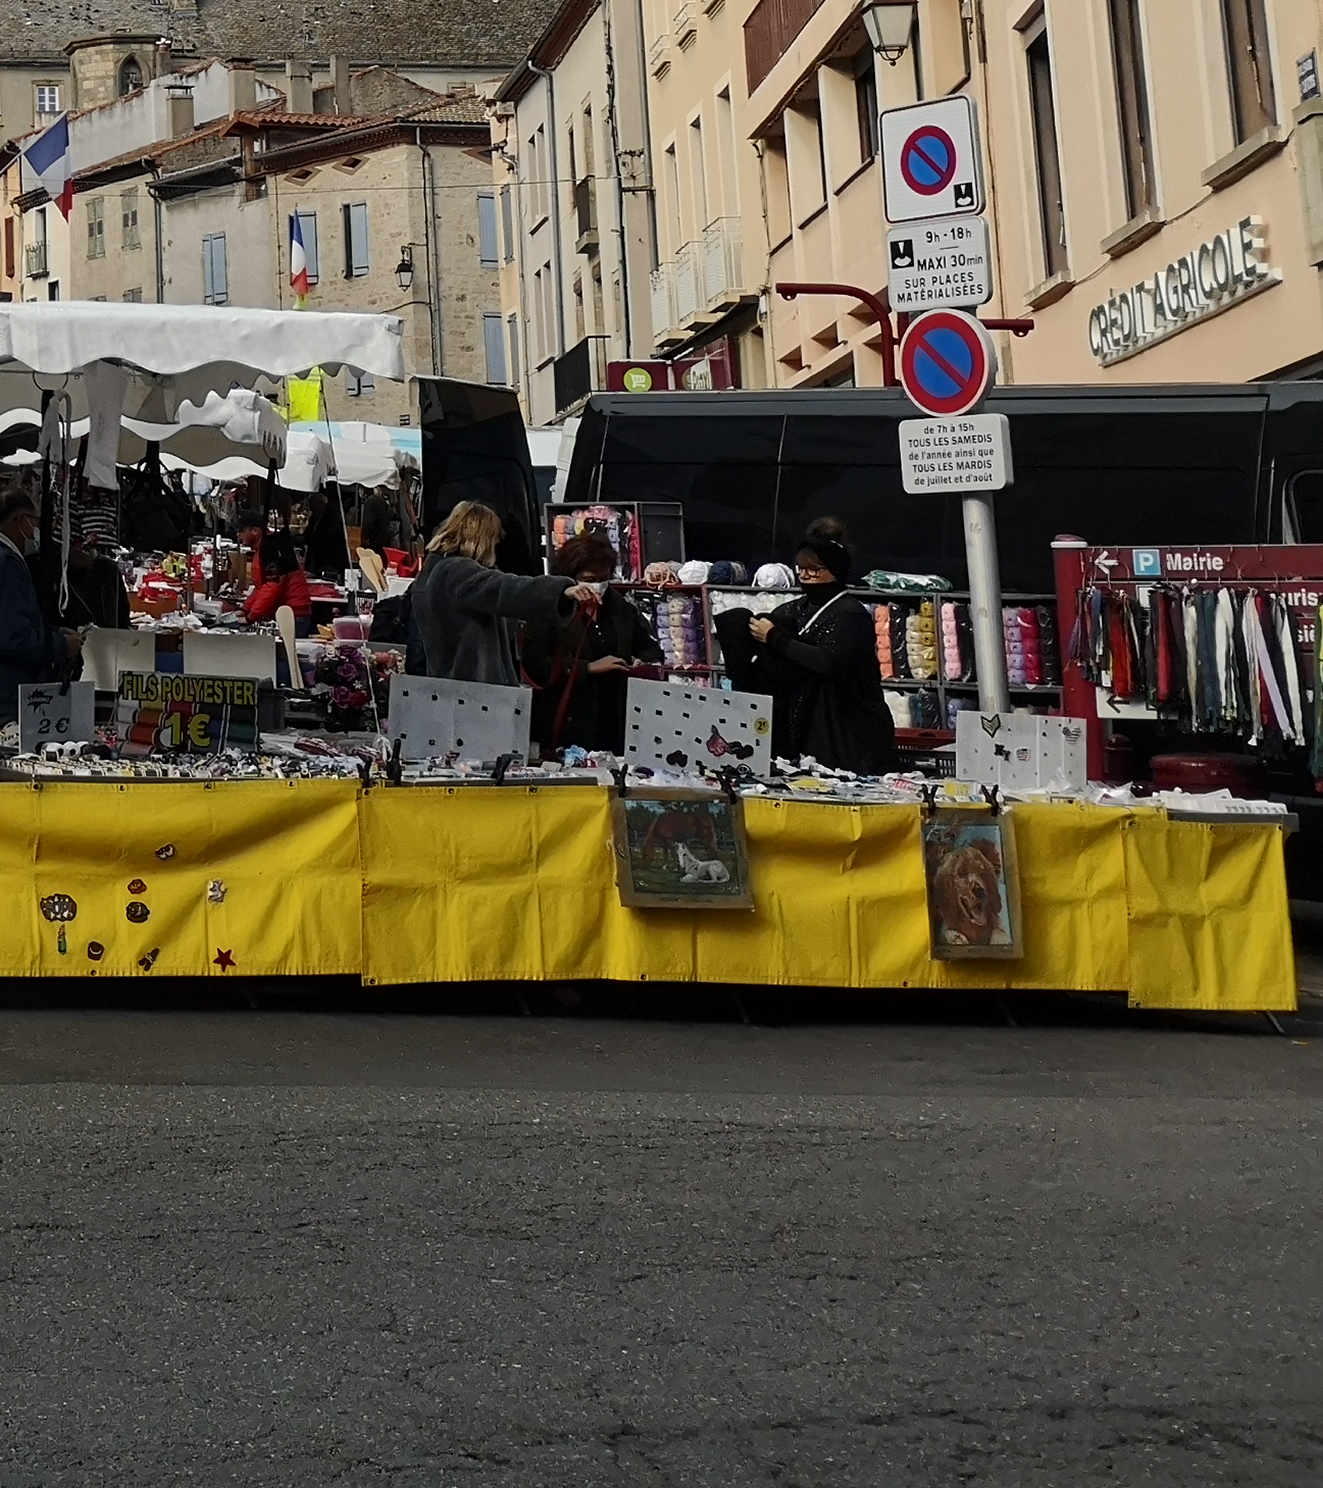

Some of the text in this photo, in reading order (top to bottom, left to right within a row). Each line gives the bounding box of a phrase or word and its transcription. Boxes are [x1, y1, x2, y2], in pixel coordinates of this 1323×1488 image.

[925, 231, 941, 243] 9h
[950, 227, 972, 241] 18h
[917, 253, 984, 272] MAXI 30min
[1155, 215, 1269, 320] AGRICOLE
[904, 271, 975, 289] SUR PLACES
[897, 283, 984, 304] MATÉRIALISÉES
[923, 422, 975, 435] de 7h à 15h
[908, 433, 993, 448] TOUS LES SAMEDIS
[908, 447, 995, 461] de l'année ainsi que
[912, 459, 993, 473] TOUS LES MARDIS
[914, 472, 993, 487] de juillet et d'août
[1165, 552, 1224, 571] Mairie
[123, 673, 255, 707] FILS POLYESTER
